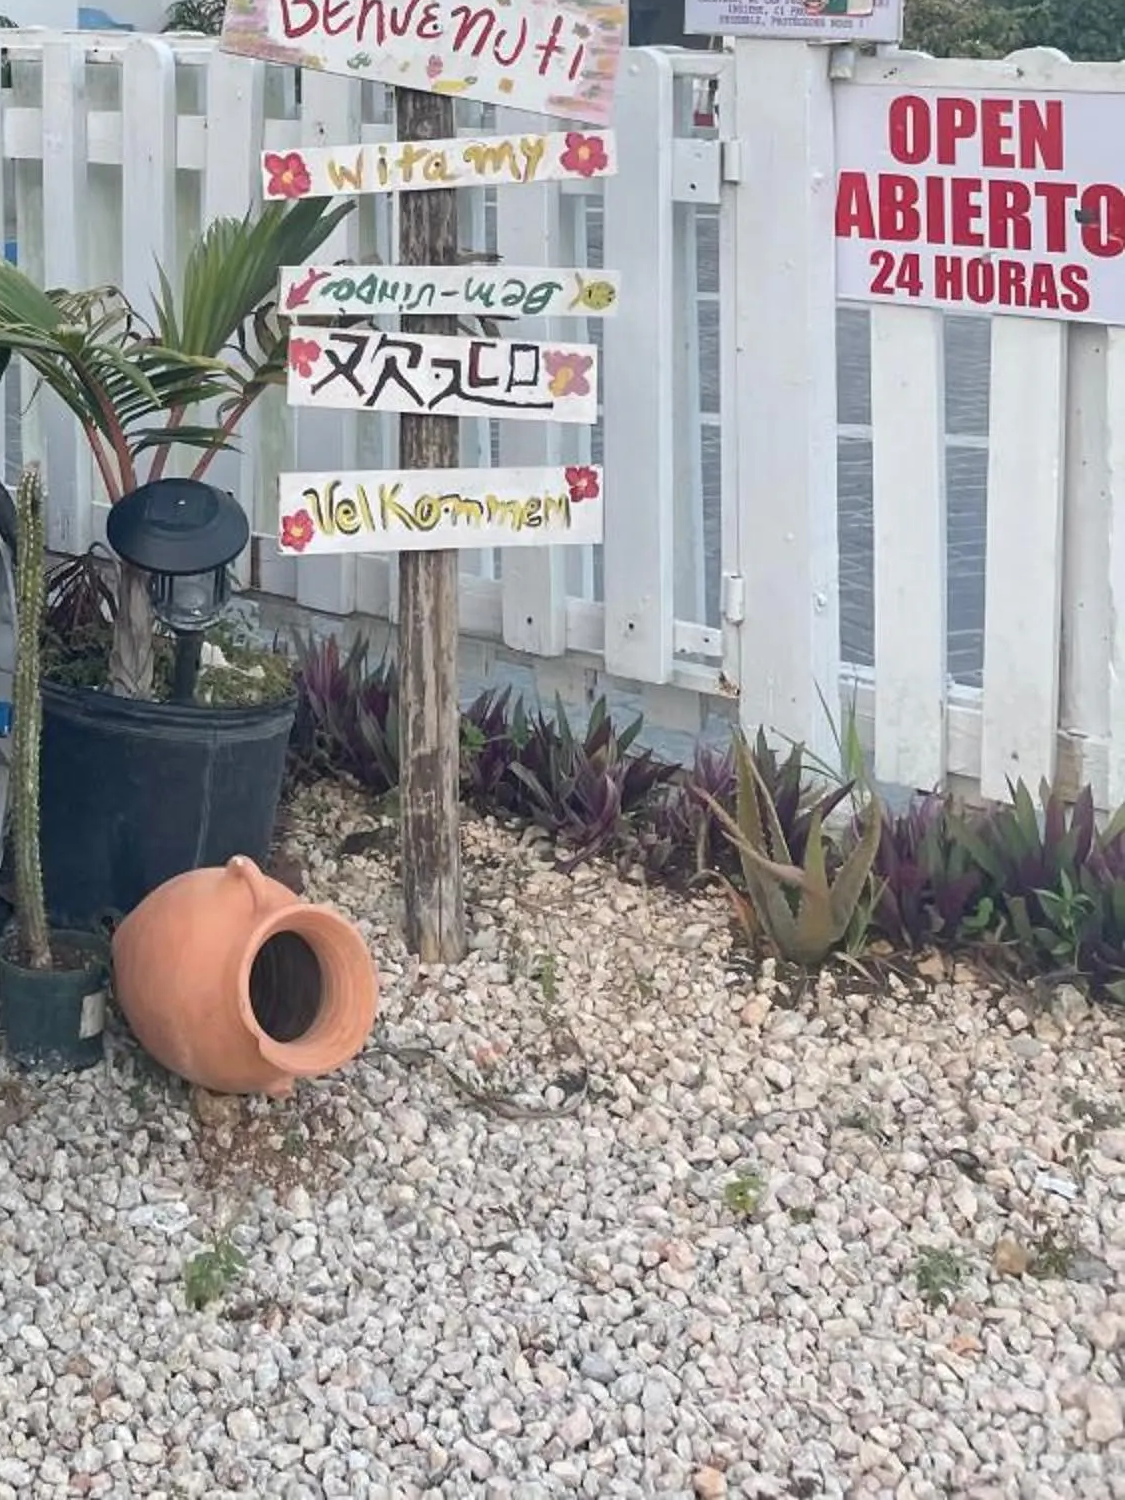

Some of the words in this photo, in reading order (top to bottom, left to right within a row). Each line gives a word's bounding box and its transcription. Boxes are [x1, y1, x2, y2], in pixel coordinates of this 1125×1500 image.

[889, 95, 1064, 170] OPEN
[835, 172, 1125, 258] ABIERTO
[870, 250, 923, 297] 24
[935, 255, 1090, 313] HORAS
